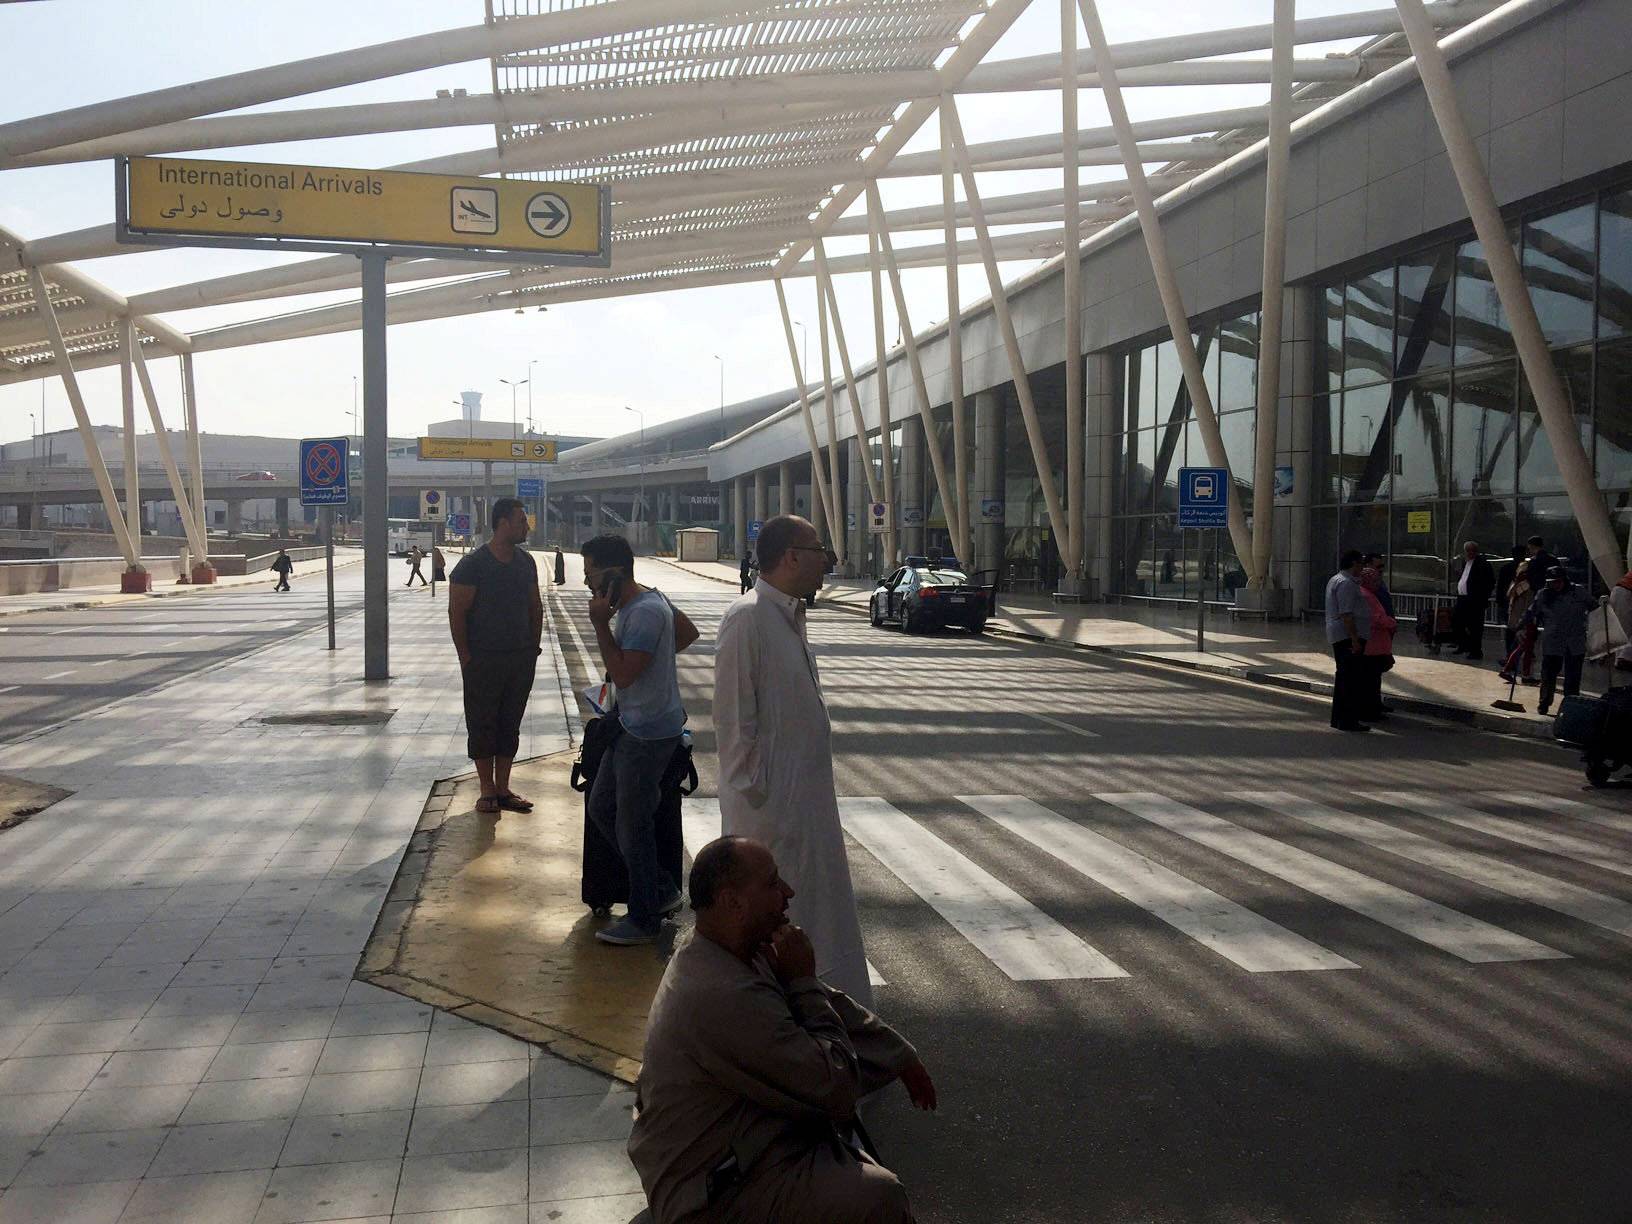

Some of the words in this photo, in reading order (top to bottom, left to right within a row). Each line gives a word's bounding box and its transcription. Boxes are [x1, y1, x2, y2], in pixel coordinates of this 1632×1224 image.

[158, 162, 295, 190] International
[302, 171, 383, 196] Arrivals
[216, 196, 284, 224] وصول
[689, 496, 719, 504] ARRIV
